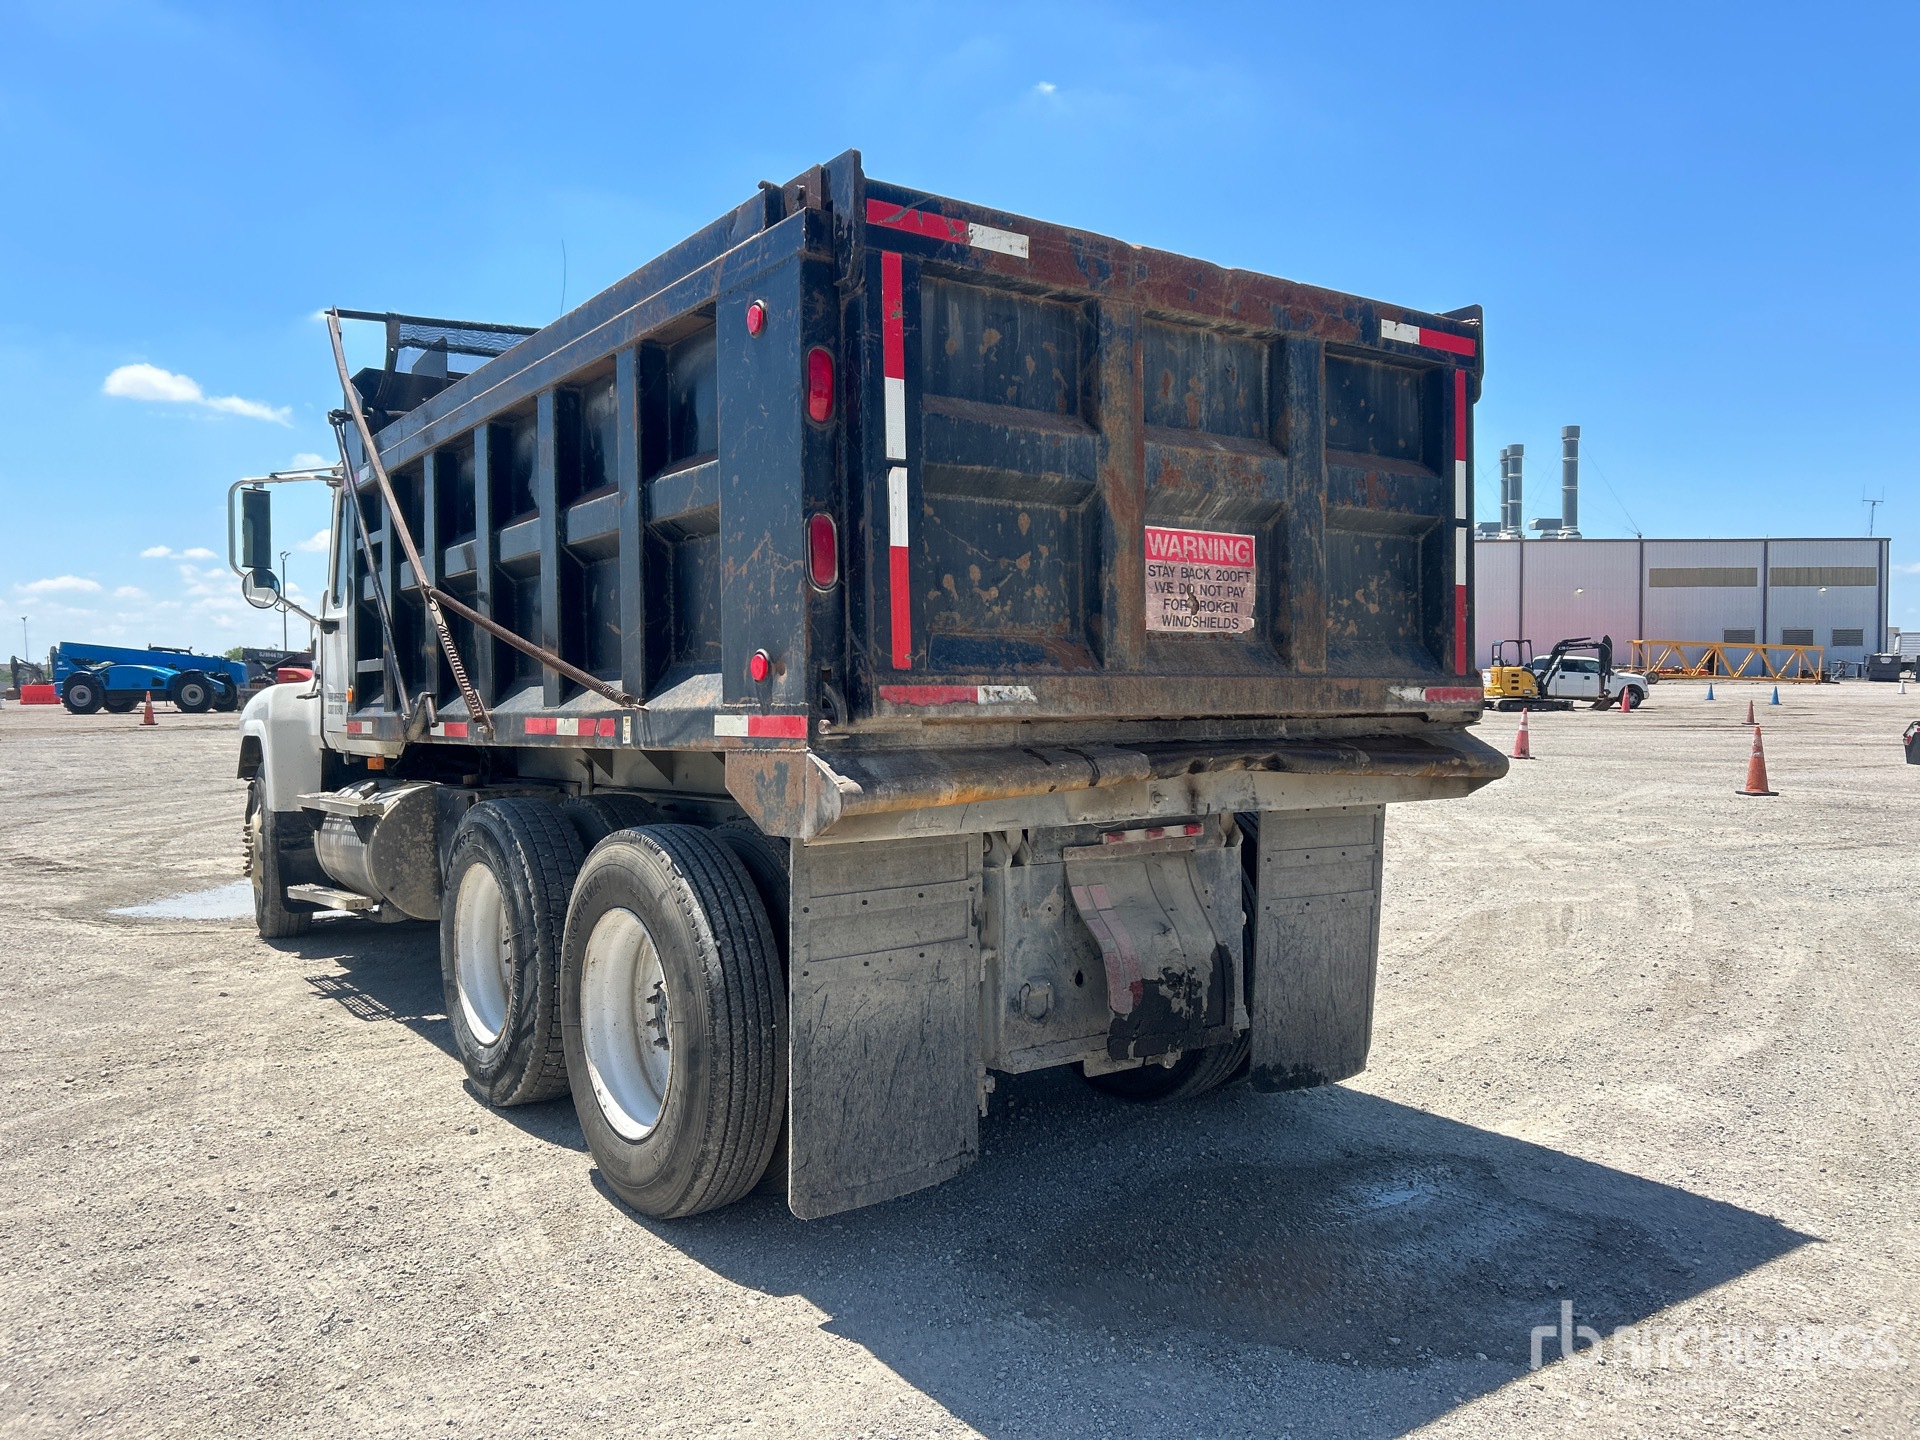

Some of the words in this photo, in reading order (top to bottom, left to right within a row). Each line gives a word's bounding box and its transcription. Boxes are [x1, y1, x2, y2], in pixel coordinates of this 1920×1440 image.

[1147, 532, 1251, 563] WARNING
[1148, 565, 1175, 578] STAY
[1181, 567, 1211, 580] BACK
[1216, 570, 1251, 583] 200FT
[1154, 582, 1174, 594] WE
[1200, 585, 1222, 597] NOT
[1227, 586, 1245, 598] PAY
[1193, 600, 1238, 613] ROKEN
[1162, 614, 1239, 629] WINDSHIELDS
[563, 875, 602, 971] YOKOHAMA
